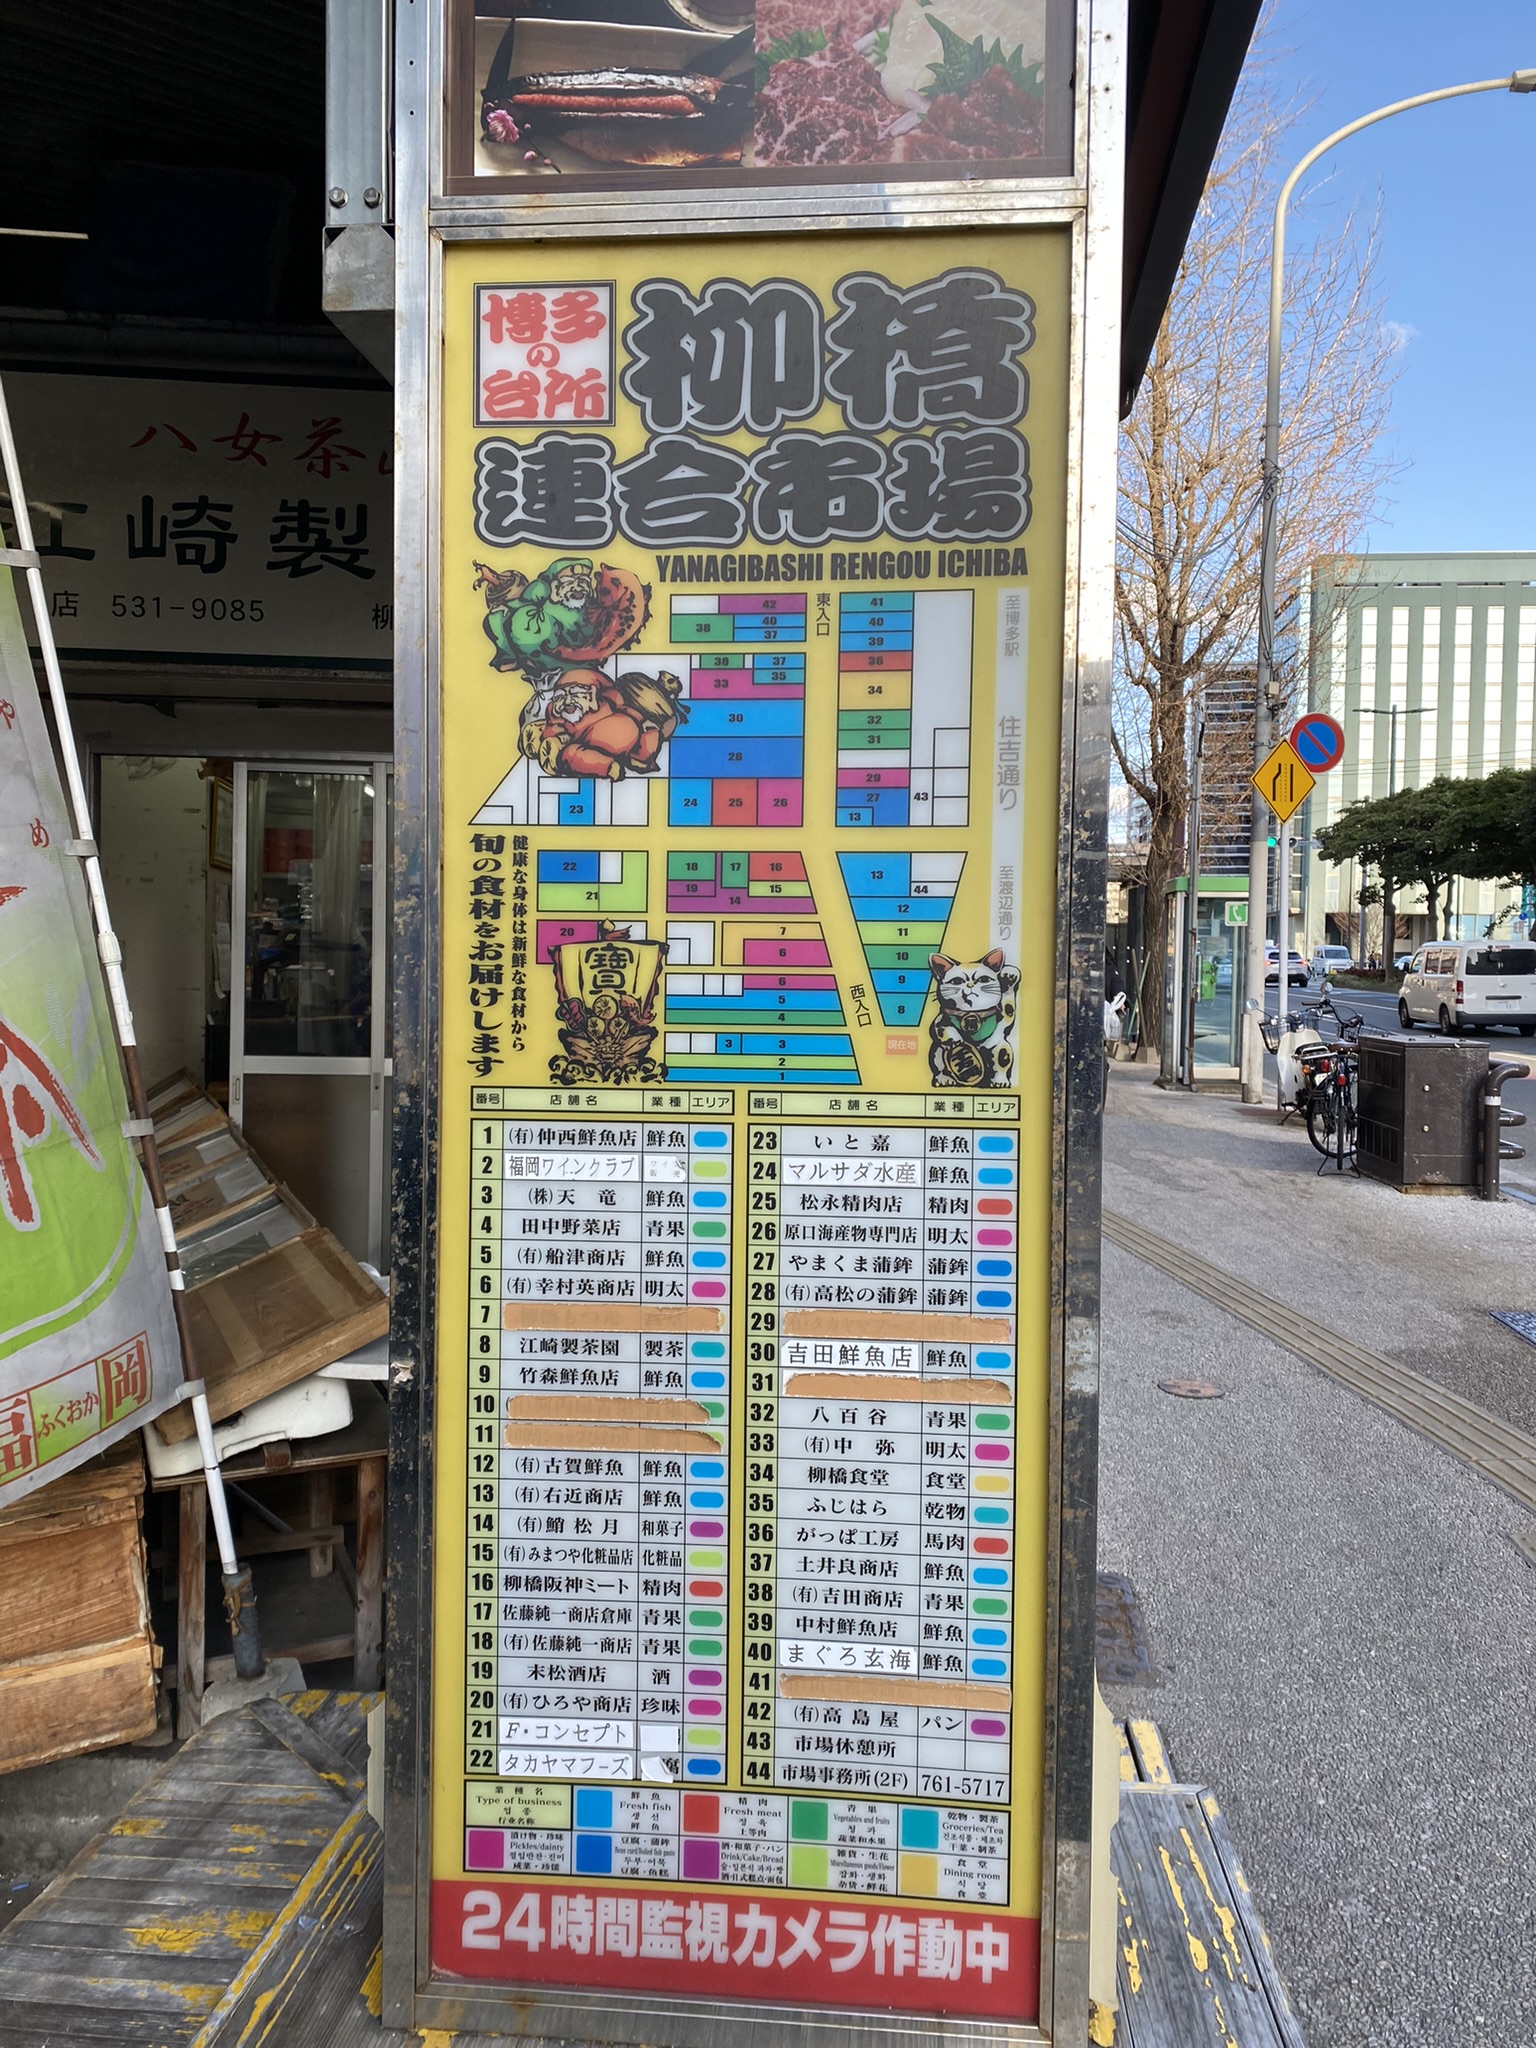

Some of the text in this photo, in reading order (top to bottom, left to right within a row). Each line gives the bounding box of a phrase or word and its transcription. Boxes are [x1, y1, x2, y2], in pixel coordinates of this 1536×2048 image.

[482, 291, 606, 343] 博多
[526, 343, 560, 367] の
[620, 267, 1037, 436] 柳橋
[483, 368, 606, 419] 台所
[131, 412, 394, 479] 八女茶
[473, 426, 1033, 550] 連合市場
[655, 549, 1028, 582] YANAGIBASHI RENGOU ICHIBA
[52, 591, 79, 618] 店
[112, 595, 264, 622] 531-9085
[762, 600, 776, 609] 42
[870, 598, 883, 606] 41
[816, 592, 830, 636] 東入口
[1004, 595, 1020, 657] 至博多駅
[714, 679, 728, 688] 33
[772, 671, 786, 680] 35
[868, 686, 882, 694] 34
[868, 716, 882, 724] 32
[998, 715, 1022, 811] 住吉通り
[866, 773, 881, 782] 29
[684, 798, 698, 807] 24
[728, 798, 742, 807] 25
[773, 798, 788, 807] 26
[914, 792, 928, 801] 43
[30, 818, 49, 848] め
[686, 863, 698, 871] 18
[770, 863, 782, 871] 16
[871, 871, 883, 879] 13
[769, 885, 781, 893] 15
[914, 886, 928, 894] 44
[729, 897, 740, 905] 14
[897, 905, 909, 913] 12
[998, 865, 1013, 941] 至渡辺通り
[780, 927, 786, 935] 7
[897, 928, 908, 936] 11
[511, 835, 528, 1052] 健康な身体は新鮮な食材から
[467, 834, 506, 1078] 旬の食材をお届けします
[779, 996, 785, 1004] 5
[850, 984, 872, 1027] 西入口
[778, 1013, 785, 1021] 4
[888, 1040, 916, 1049] 現在地
[779, 1058, 785, 1066] 2
[476, 1094, 500, 1104] 番号
[652, 1095, 681, 1107] 業種
[692, 1097, 730, 1107] エリア
[753, 1098, 778, 1109] 番号
[934, 1102, 964, 1112] 業種
[977, 1102, 1016, 1112] エリア
[483, 1127, 637, 1146] 1 (有)仲西鮮魚店
[753, 1132, 777, 1149] 23
[789, 1162, 969, 1184] マルサダ水産 鮮魚
[482, 1186, 492, 1204] 3
[800, 1194, 902, 1212] 松永精肉店
[522, 1218, 685, 1237] 田中野菜店 青果
[785, 1224, 917, 1243] 原口海産物専門店
[518, 1248, 625, 1265] (有)船津商店
[753, 1252, 912, 1273] 27 やまくま蒲鉾
[645, 1281, 684, 1297] 明太
[786, 1285, 967, 1306] (有)高松の蒲鉾 蒲鉾
[481, 1306, 490, 1323] 7
[751, 1313, 775, 1330] 29
[520, 1337, 683, 1357] 江崎製茶園 製茶
[788, 1343, 911, 1367] 吉田鮮魚店
[102, 1340, 146, 1423] 岡
[520, 1367, 619, 1386] 竹森鮮魚店
[752, 1373, 773, 1391] 31
[474, 1395, 494, 1412] 10
[38, 1393, 99, 1439] ふくおか
[811, 1406, 887, 1425] 八百谷
[475, 1426, 492, 1442] 11
[750, 1434, 774, 1451] 33
[515, 1458, 682, 1477] (有)古賀鮮魚 鮮魚
[807, 1466, 966, 1489] 柳橋食堂 食堂
[515, 1487, 623, 1506] (有)右近商店
[807, 1497, 965, 1520] ふじはら 乾物
[642, 1520, 683, 1537] 和菓子
[925, 1533, 964, 1550] 馬肉
[473, 1544, 633, 1565] 15 (有)みまつや化粧品店
[751, 1554, 898, 1577] 37 土井良商店
[503, 1575, 681, 1596] 柳橋阪神ミート 精肉
[793, 1586, 902, 1608] (有)吉田商店
[474, 1603, 631, 1624] 17 佐藤純一商店倉庫
[796, 1617, 897, 1638] 中村鮮魚店
[504, 1635, 631, 1654] (有)佐藤純一商店
[788, 1645, 910, 1669] まぐろ玄海
[472, 1662, 492, 1678] 19
[750, 1673, 769, 1690] 41
[503, 1694, 680, 1715] (有)ひろや商店 珍味
[471, 1721, 492, 1737] 21
[922, 1717, 962, 1731] パン
[747, 1733, 896, 1757] 43 市場休憩所
[470, 1750, 492, 1767] 22
[782, 1766, 1004, 1797] 市場事務所(2F) 761-5717
[476, 1796, 500, 1804] Type
[518, 1798, 562, 1806] business
[620, 1802, 671, 1811] Fresh fish
[724, 1807, 753, 1816] Fresh
[834, 1814, 862, 1823] Vegetables
[875, 1817, 890, 1825] fruits
[942, 1822, 1004, 1834] Groceries/Tea
[511, 1842, 564, 1852] Pickles/dainty
[721, 1853, 783, 1863] Drink/Cake/Bread
[944, 1868, 973, 1878] Dining
[461, 1889, 1010, 1984] 24時間監視カメラ作動中
